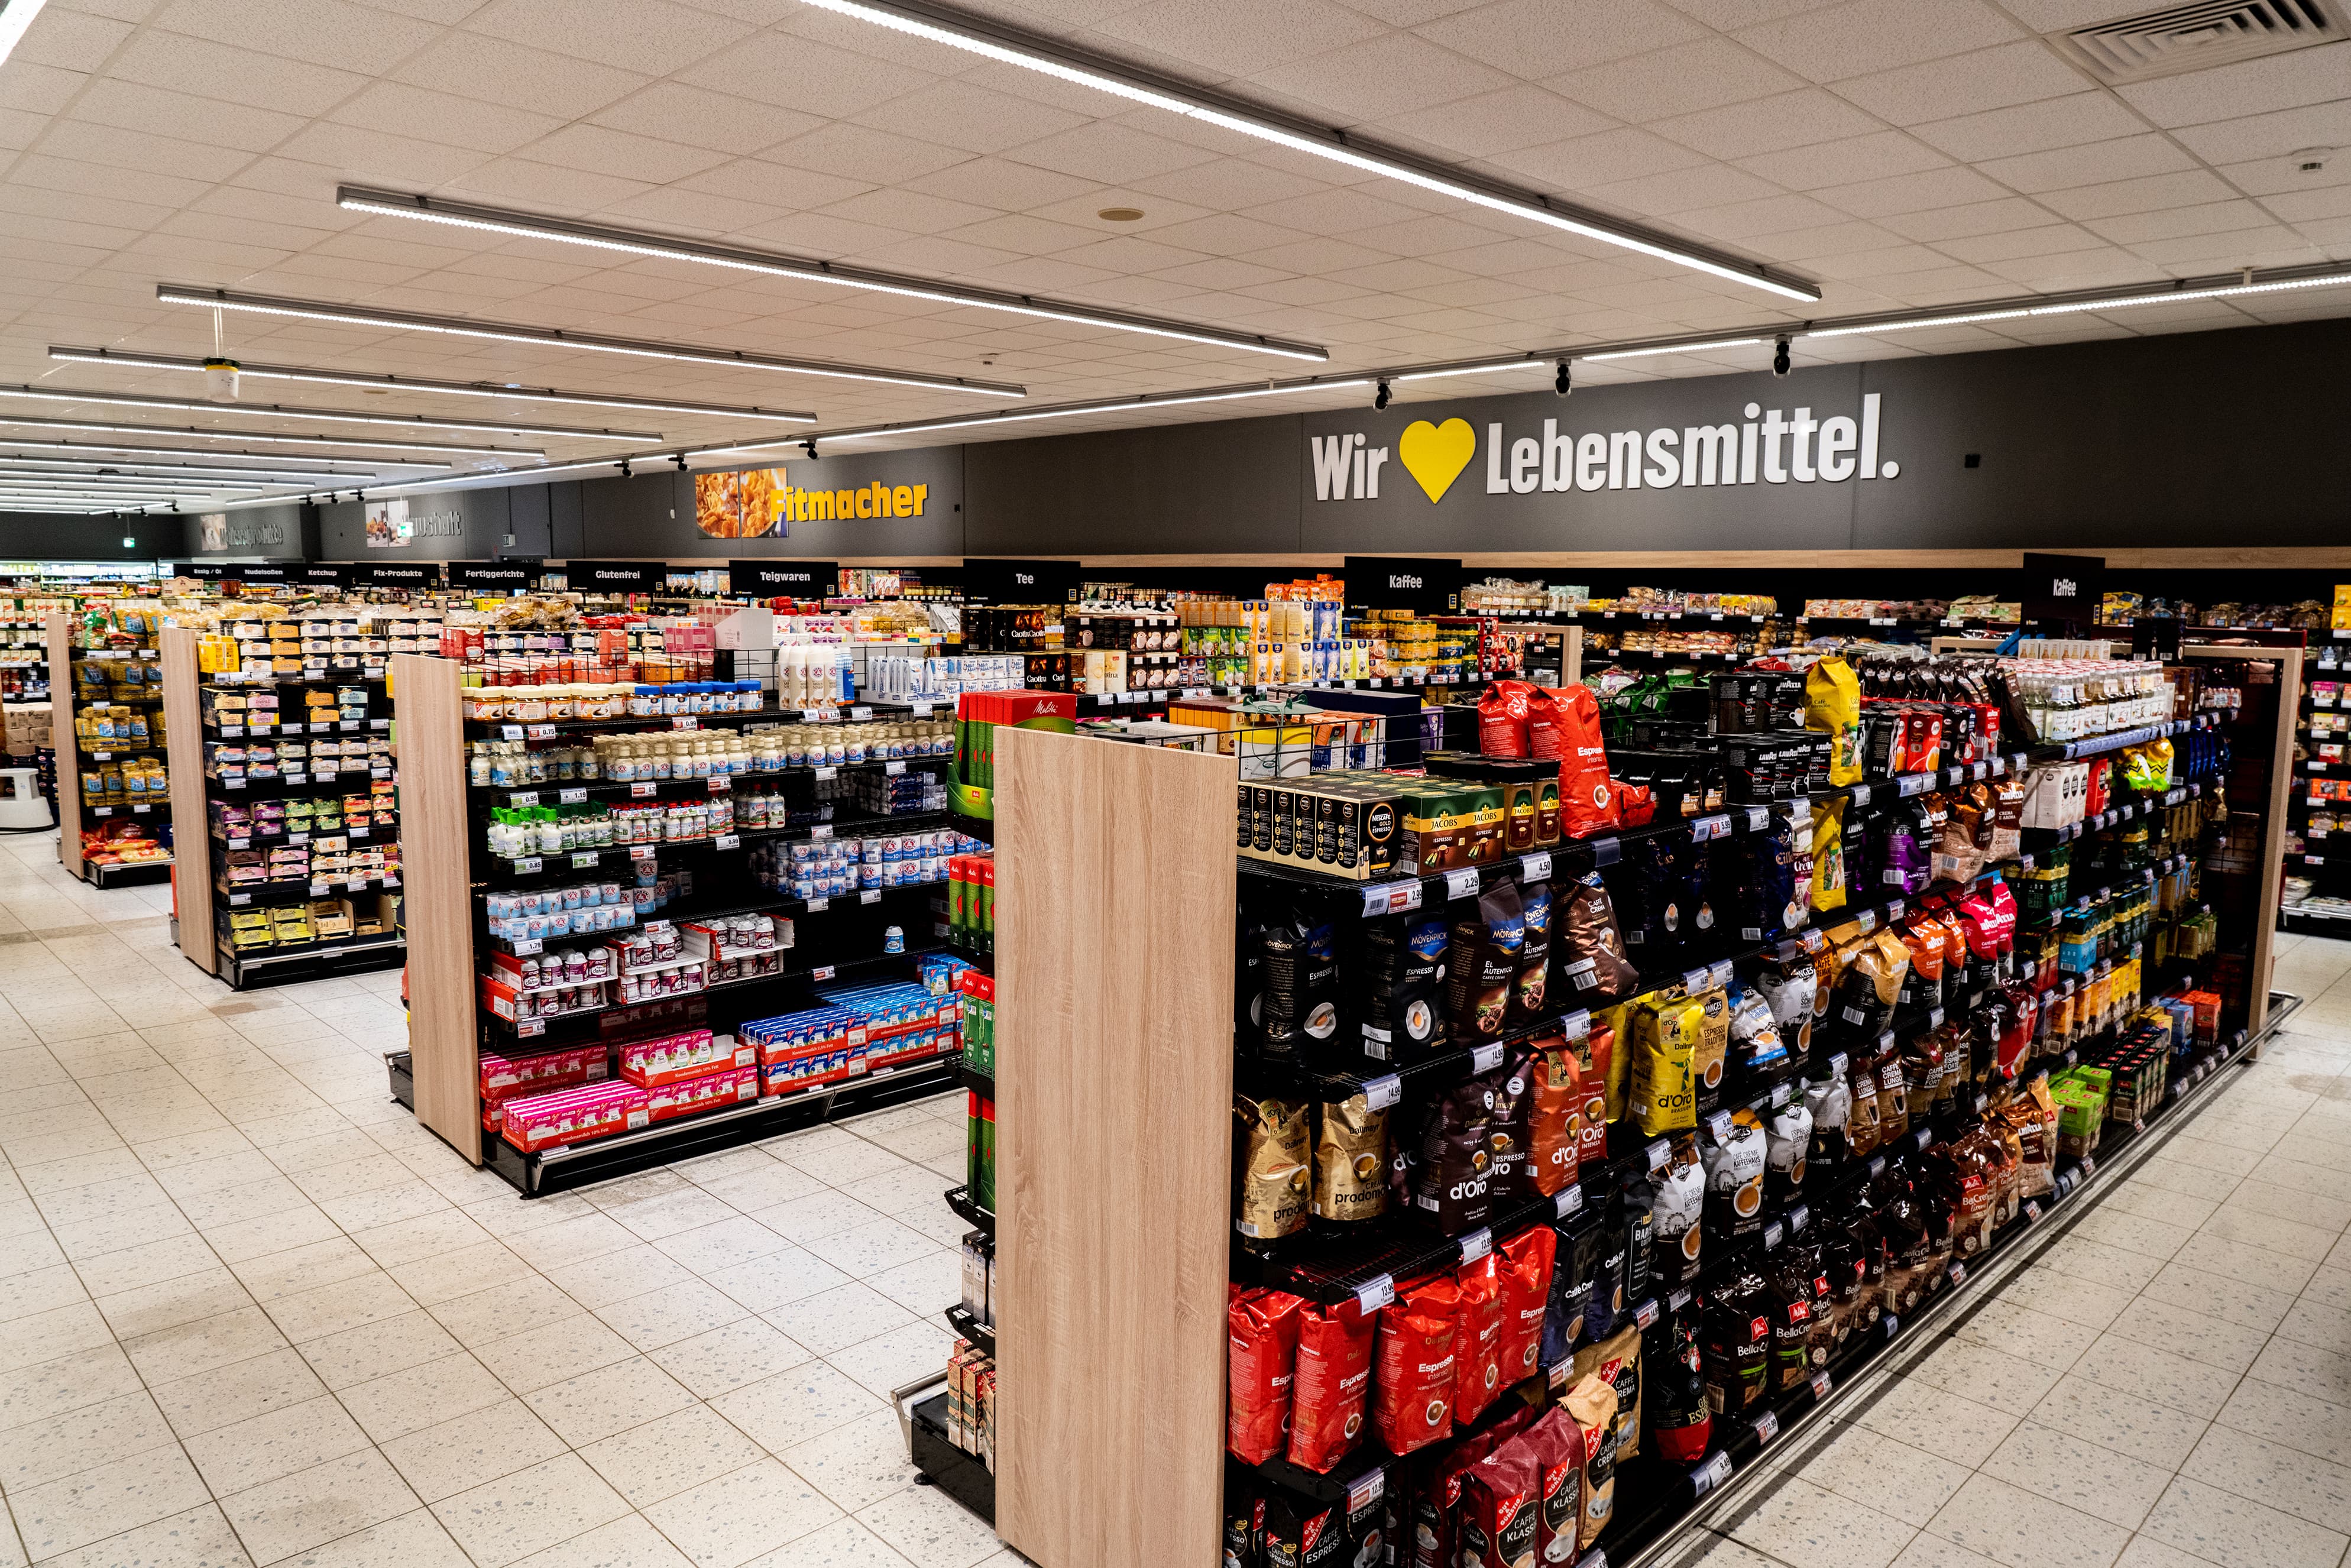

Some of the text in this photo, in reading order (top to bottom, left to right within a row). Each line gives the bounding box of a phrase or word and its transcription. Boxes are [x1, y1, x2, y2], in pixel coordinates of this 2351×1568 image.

[1311, 393, 1900, 502] Wir Lebensmittel.
[770, 481, 928, 521] Fitmacher
[466, 570, 524, 578] Fertiggerichte
[596, 570, 640, 580] Glutenfrei
[760, 572, 810, 583] Teigwaren
[1016, 574, 1034, 584] Tee
[1390, 575, 1422, 589] Kaffee
[2053, 579, 2077, 597] Kaffee
[1033, 700, 1057, 715] Melitta
[1578, 746, 1603, 757] Espresso
[1542, 801, 1559, 809] JACOBS
[1372, 814, 1391, 822] NESCAFÉ
[1473, 811, 1497, 822] JACOBS
[1760, 814, 1769, 822] 5.49
[1430, 816, 1458, 830] JACOBS
[1721, 819, 1731, 831] 5.99
[1539, 862, 1551, 872] 4.50
[1465, 876, 1478, 889] 2.29
[1412, 890, 1421, 900] 2.99
[1588, 897, 1602, 908] CAFFÈ
[1590, 904, 1606, 913] CREMA
[1411, 929, 1447, 945] MÖVENPICK
[1524, 942, 1547, 955] AUTENTICO
[1309, 967, 1332, 980] ESPRESSO
[1406, 966, 1433, 976] ESPRESSO
[1483, 966, 1513, 975] AUTENTICO
[1581, 1019, 1591, 1030] 14.99
[1704, 1026, 1725, 1036] ESPRESSO
[1704, 1035, 1726, 1047] TRADITION
[792, 1045, 818, 1055] Kondensmilch
[1492, 1049, 1503, 1060] 14.99
[675, 1068, 700, 1078] Kondensmilch
[1882, 1064, 1899, 1074] CAFFÈ
[1883, 1069, 1903, 1081] CREMA
[794, 1076, 818, 1087] Kondensmilch
[1857, 1078, 1873, 1090] CREMA
[1884, 1076, 1903, 1087] LUNGO
[1388, 1086, 1401, 1098] 14.99
[1858, 1086, 1874, 1095] LUNGO
[677, 1102, 704, 1112] Kondensmilch
[1658, 1094, 1692, 1108] d'Oro
[1670, 1104, 1691, 1113] BRASILIEN
[1722, 1117, 1732, 1128] 9.49
[1349, 1123, 1379, 1135] Dallmayr
[560, 1132, 590, 1142] Kondensmilch
[1285, 1135, 1309, 1150] Dallmayr
[1582, 1141, 1601, 1149] INTENSA
[1496, 1152, 1525, 1162] ESPRESSO
[1733, 1149, 1759, 1161] CAFÉ CRÈME
[1564, 1159, 1577, 1169] INTENSA
[1734, 1157, 1761, 1167] KAFFEEHAUS
[1335, 1185, 1386, 1204] prodomo
[1450, 1180, 1486, 1200] d'Oro
[1572, 1193, 1582, 1203] 13.99
[1481, 1238, 1492, 1250] 13.99
[1381, 1284, 1394, 1297] 13.99
[1231, 1336, 1249, 1348] Espresso
[1300, 1343, 1320, 1356] Espresso
[1418, 1355, 1453, 1373] Espresso
[1340, 1366, 1370, 1389] Espresso
[1427, 1369, 1449, 1381] intenso
[1615, 1375, 1634, 1388] CAFFÈ
[1766, 1419, 1777, 1433] 12.99
[1599, 1440, 1615, 1456] CAFFÈ
[1597, 1449, 1617, 1469] CREMA
[1719, 1459, 1730, 1471] 9.49
[1545, 1469, 1557, 1483] GUT
[1371, 1482, 1384, 1495] 12.99
[1559, 1485, 1578, 1498] CAFFÈ
[1553, 1494, 1579, 1510] KLASSIK
[1498, 1503, 1511, 1515] GUT
[1514, 1514, 1536, 1529] CAFFÈ
[1507, 1524, 1538, 1542] KLASSIK
[1317, 1533, 1339, 1550] CAFFÈ
